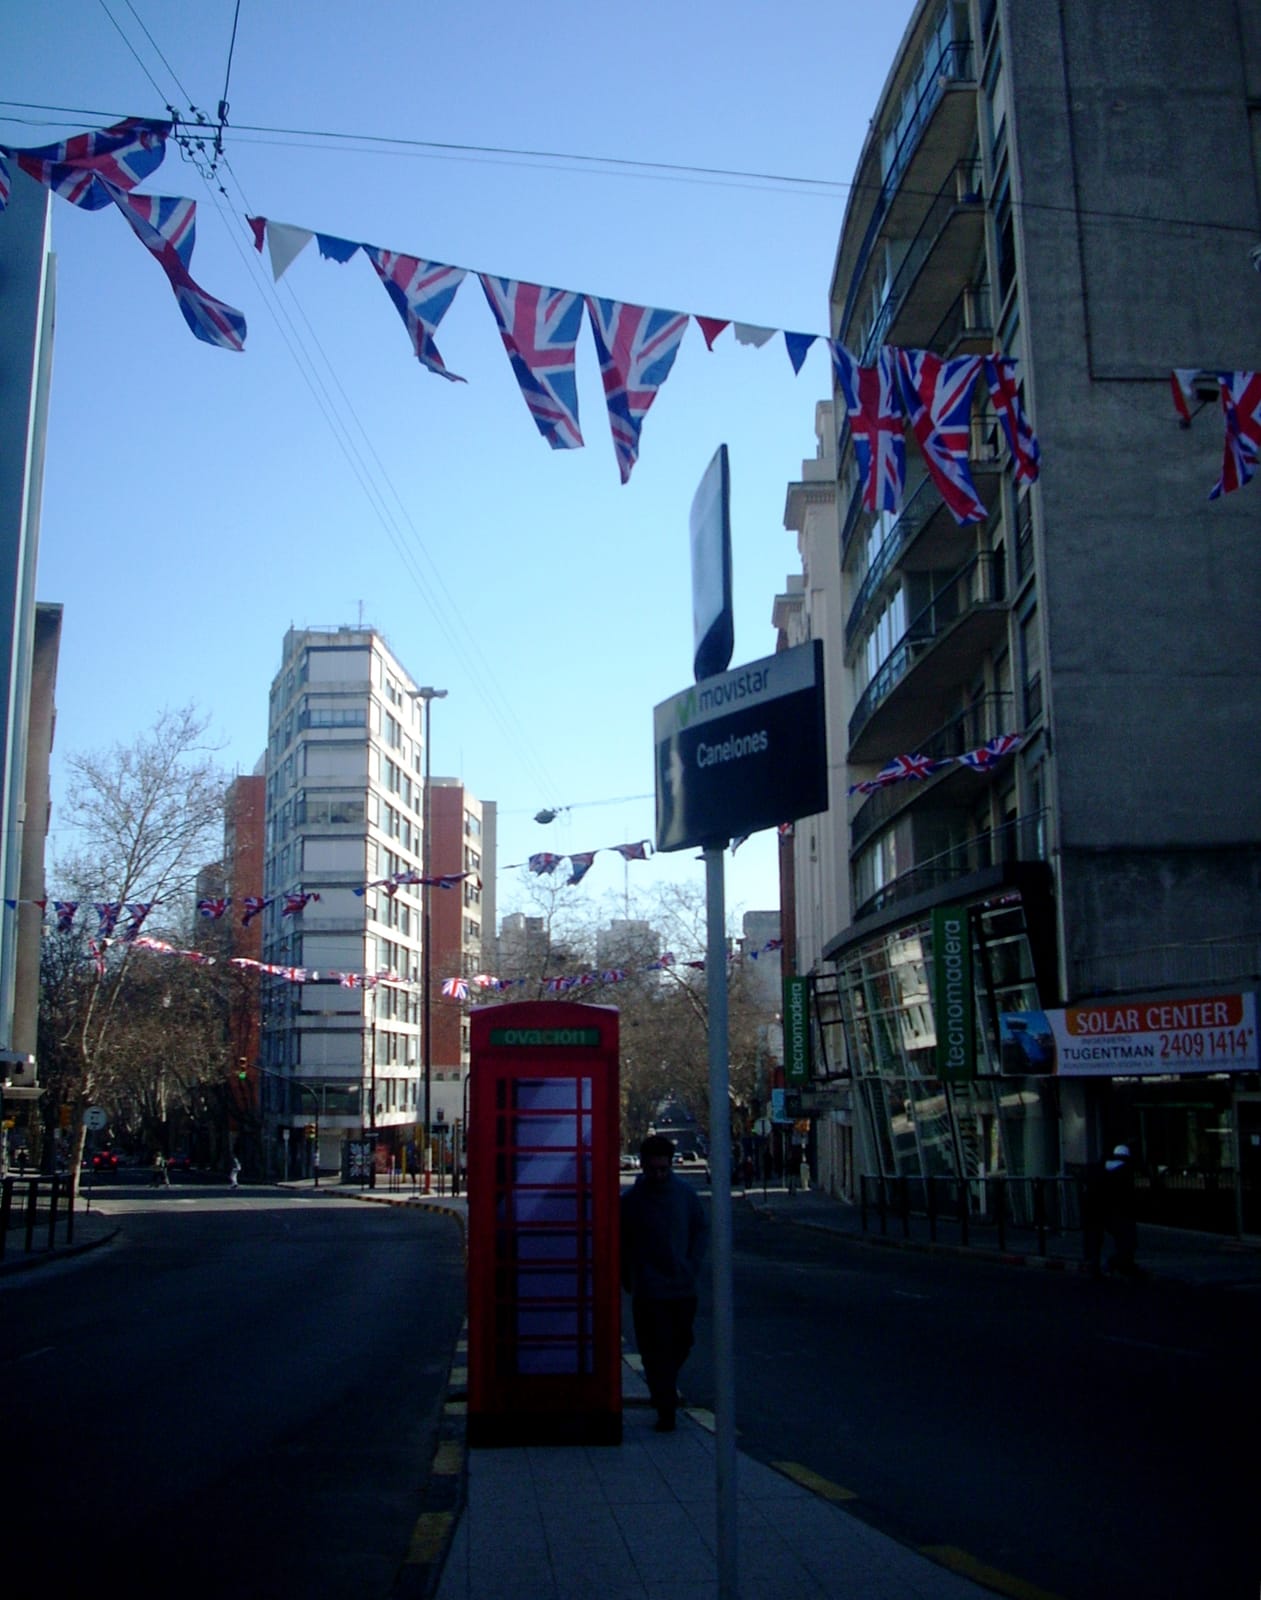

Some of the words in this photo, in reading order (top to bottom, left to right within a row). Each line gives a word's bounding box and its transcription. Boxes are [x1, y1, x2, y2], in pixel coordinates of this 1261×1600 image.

[699, 668, 769, 712] movistar
[696, 729, 769, 768] Canelones
[943, 919, 965, 1068] tecnomadera
[790, 982, 804, 1076] tecnomadera
[1076, 1009, 1140, 1034] SOLAR
[1145, 1001, 1229, 1030] CENTER
[1063, 1045, 1154, 1061] TUGENTMAN
[1160, 1032, 1204, 1058] 2409
